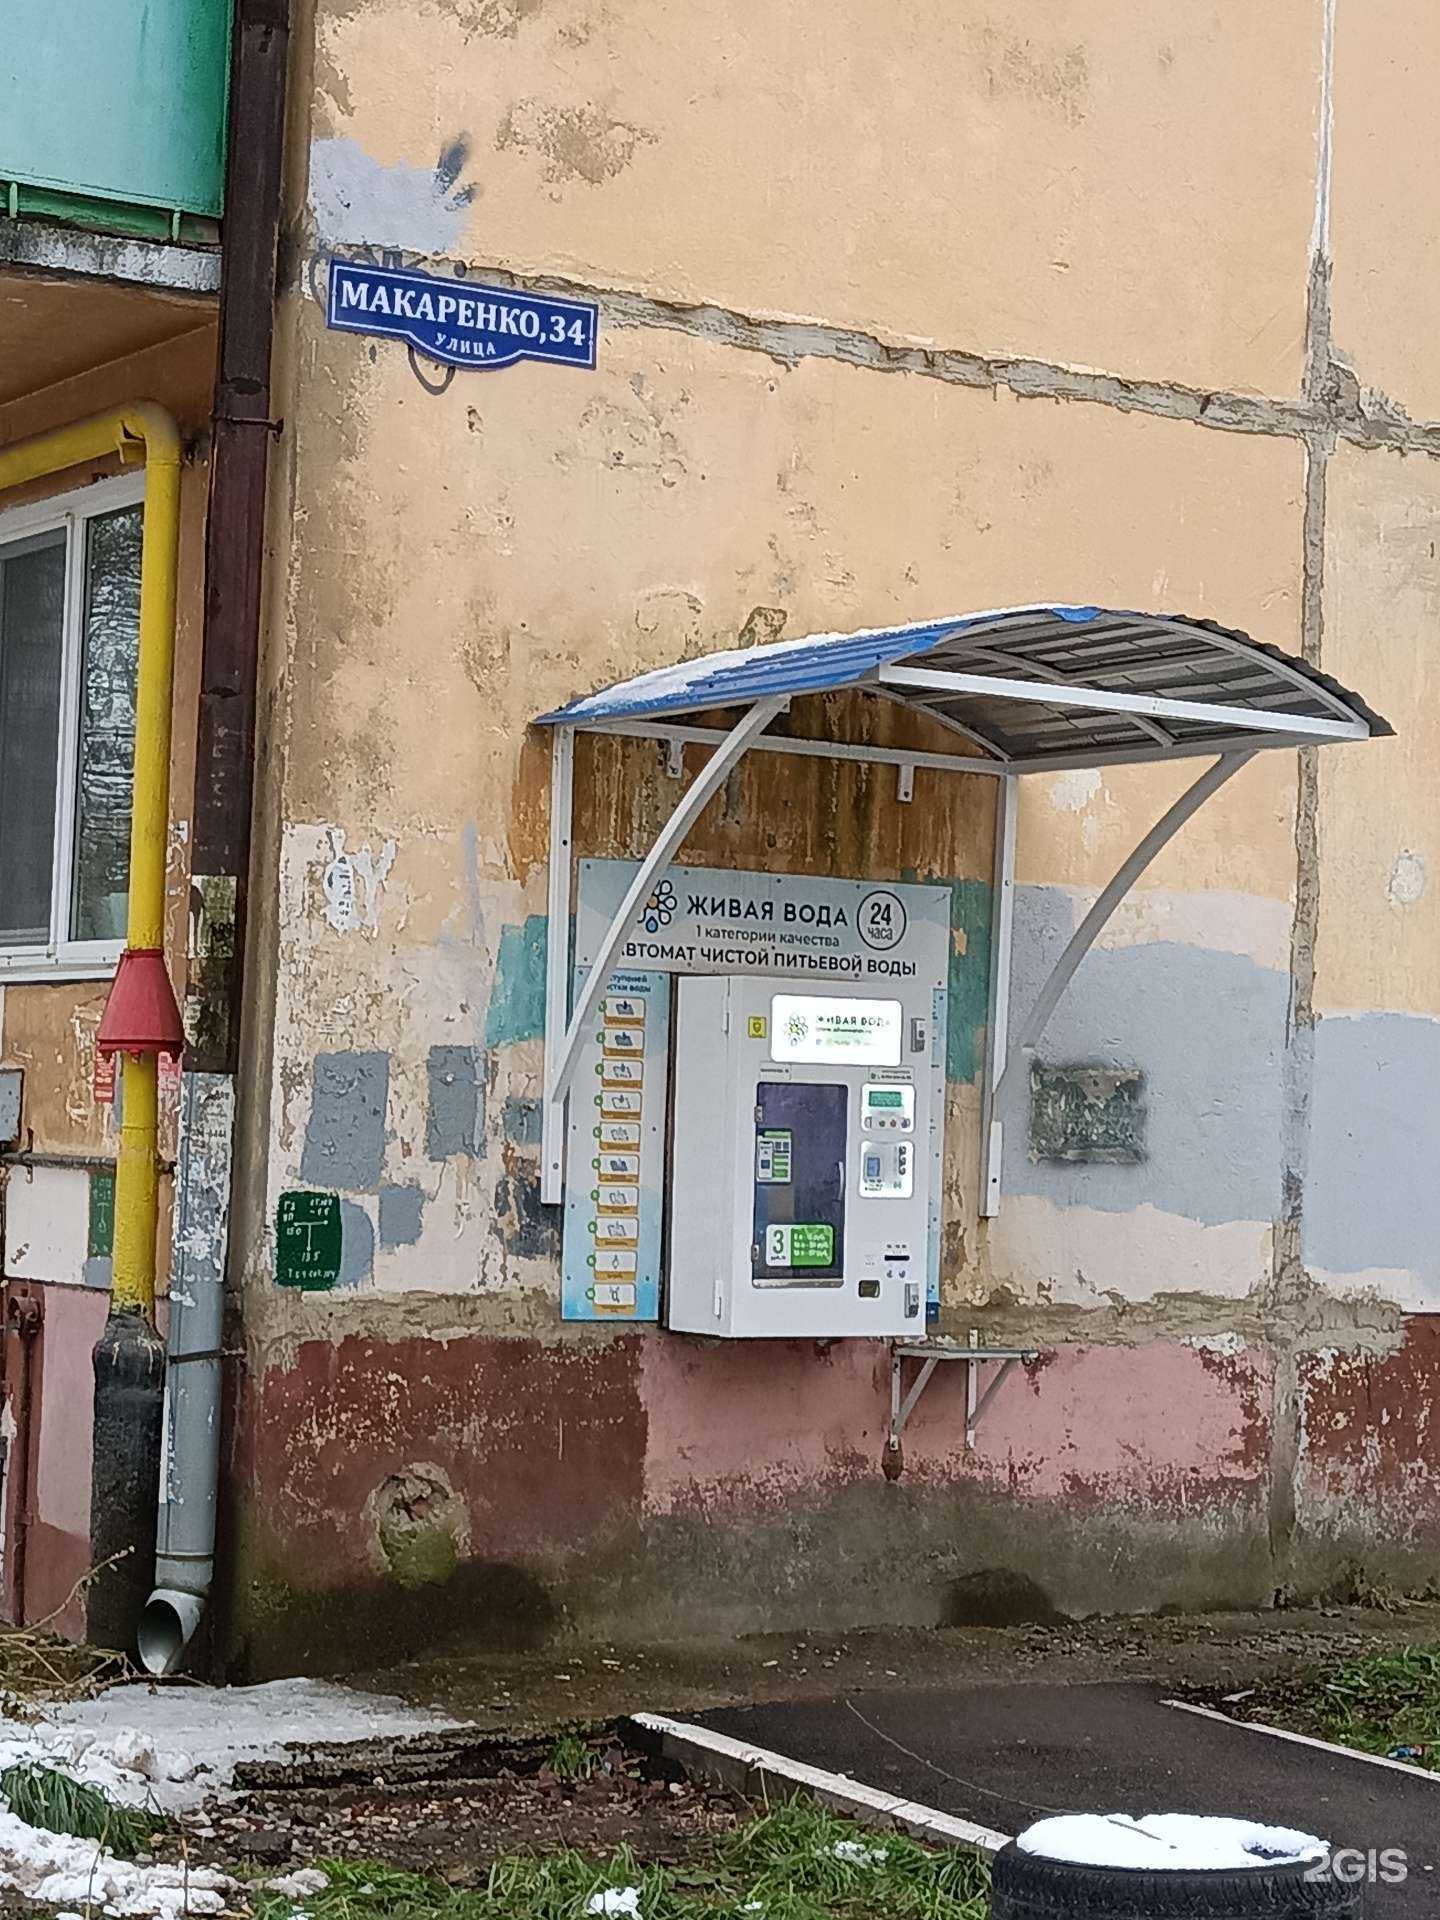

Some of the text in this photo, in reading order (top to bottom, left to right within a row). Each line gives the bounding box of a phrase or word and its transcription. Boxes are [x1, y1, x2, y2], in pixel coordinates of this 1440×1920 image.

[340, 280, 587, 347] МАКАРЕНКО,34
[434, 332, 498, 359] УЛИЦА
[687, 895, 848, 927] ЖИВАЯ ВОДА
[870, 902, 892, 926] 24
[696, 924, 840, 948] 1 категории качества
[867, 925, 894, 942] часа
[700, 945, 769, 967] ЧИСТОЙ
[774, 951, 862, 973] ПИТЬЕВОЙ
[867, 959, 917, 977] ВОДЫ
[772, 1229, 785, 1255] 3
